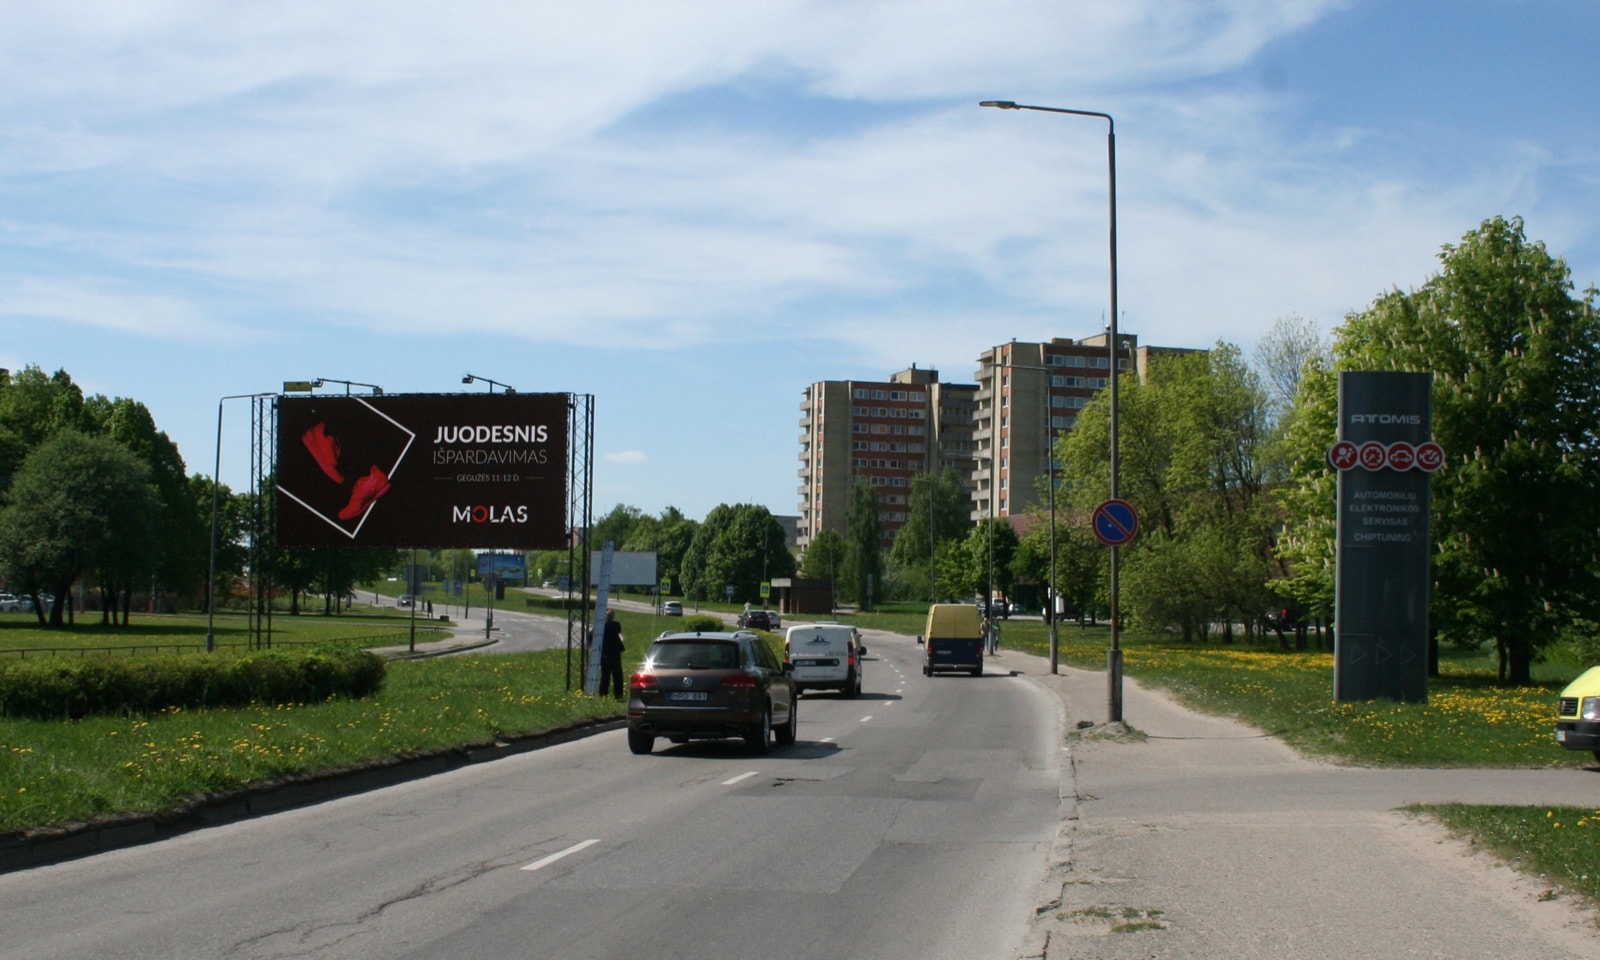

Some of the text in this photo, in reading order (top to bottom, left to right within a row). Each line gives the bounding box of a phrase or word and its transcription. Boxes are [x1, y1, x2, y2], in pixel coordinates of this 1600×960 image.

[1351, 414, 1421, 425] ATOMIS
[434, 425, 548, 444] JUODESNIS
[433, 447, 547, 465] IŠPARDAVIMAS
[1349, 503, 1420, 513] ELEKTRONIKOS
[452, 505, 528, 523] MOLAS
[1361, 516, 1408, 526] SERVISAS
[1353, 532, 1412, 542] CHIPTUNING
